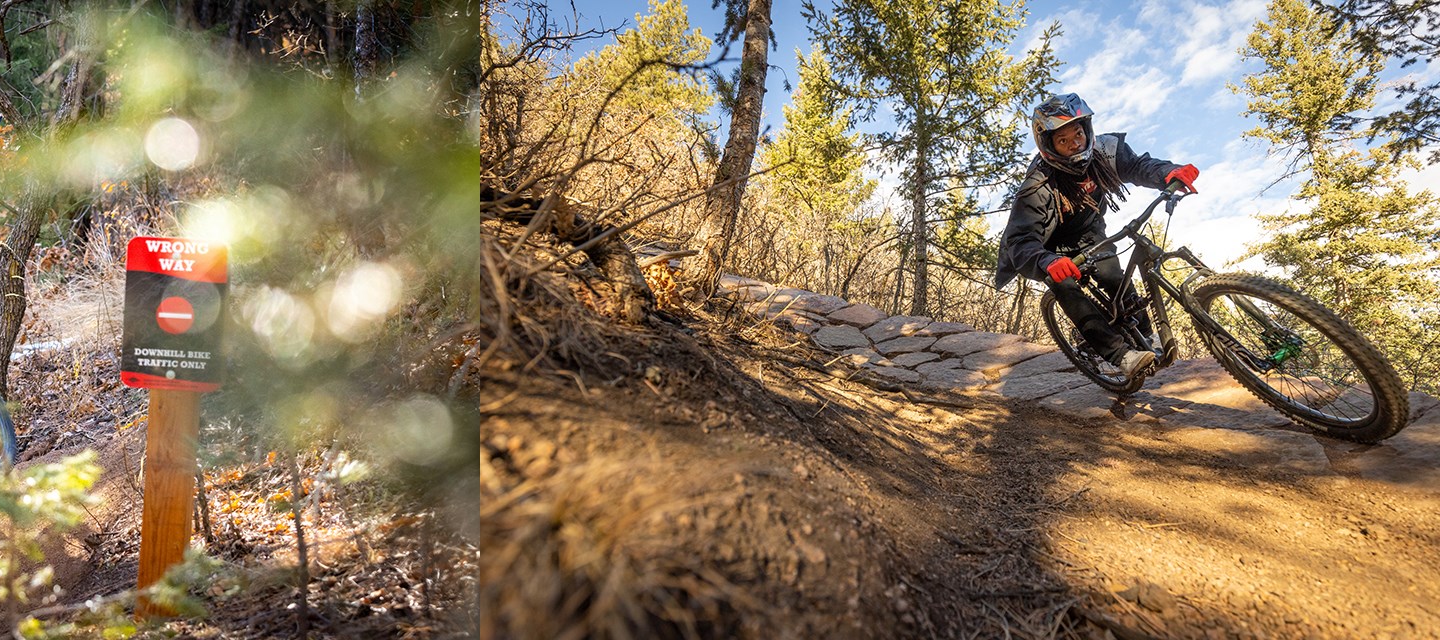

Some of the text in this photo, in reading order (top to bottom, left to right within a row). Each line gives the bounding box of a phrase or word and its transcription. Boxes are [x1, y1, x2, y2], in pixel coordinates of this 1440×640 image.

[145, 240, 209, 254] WRONG
[158, 258, 195, 272] WAY
[134, 348, 211, 359] DOWNHILL BIKE
[137, 358, 207, 369] TRAFFIC ONLY
